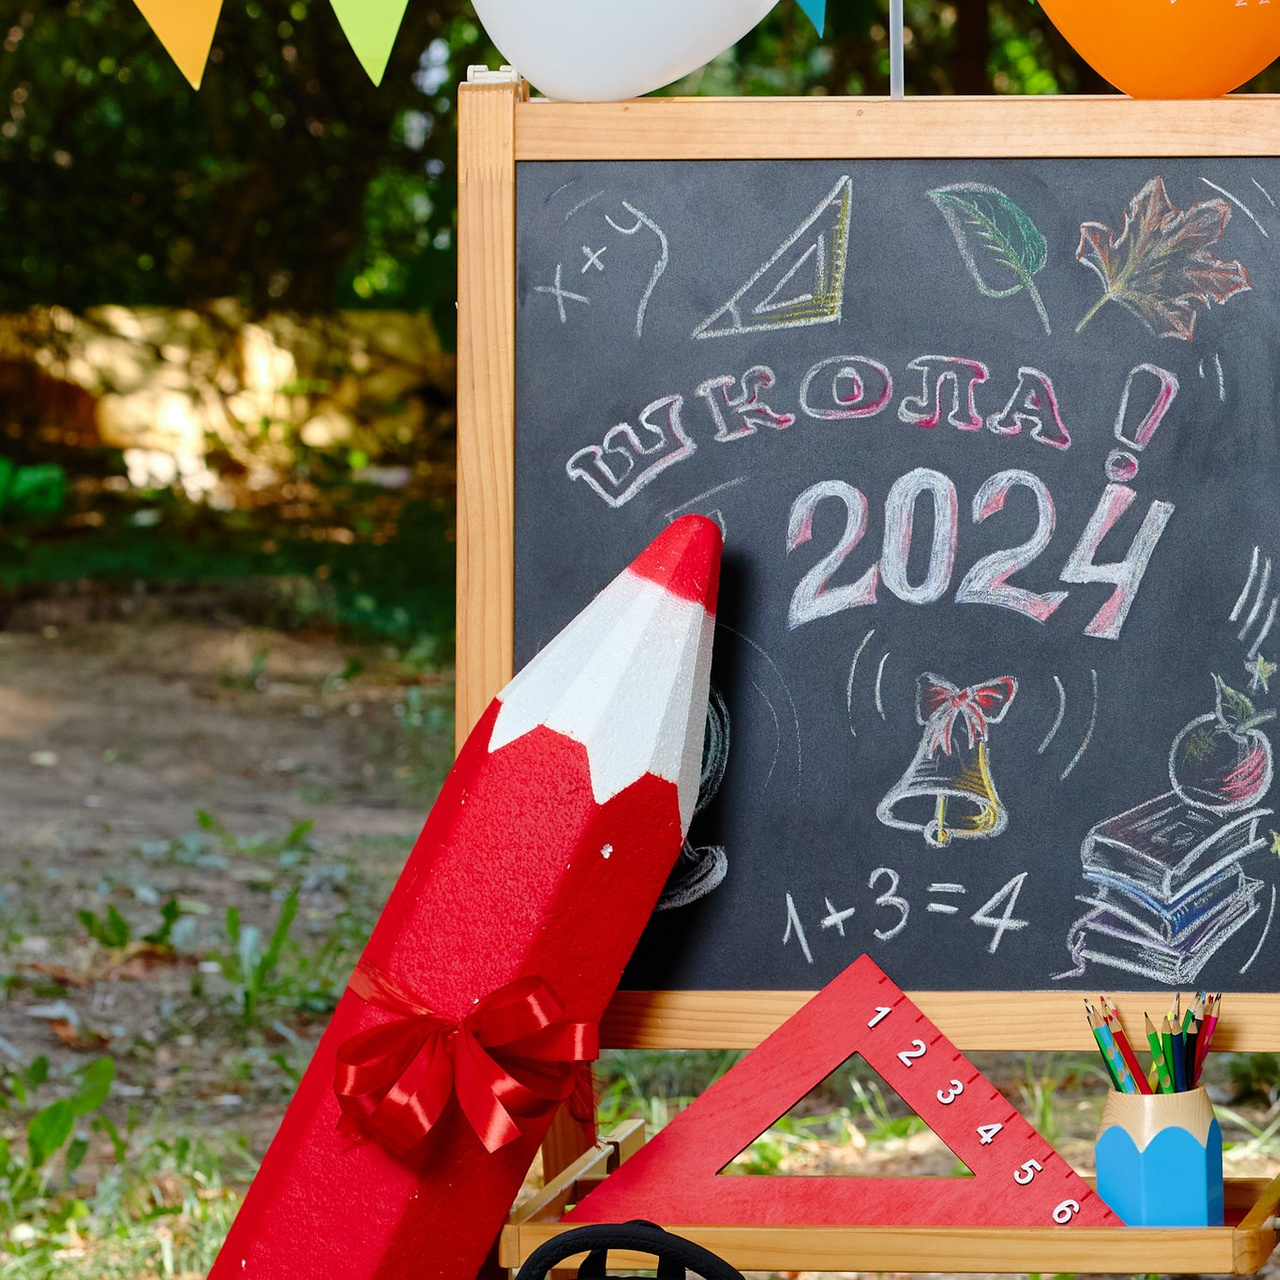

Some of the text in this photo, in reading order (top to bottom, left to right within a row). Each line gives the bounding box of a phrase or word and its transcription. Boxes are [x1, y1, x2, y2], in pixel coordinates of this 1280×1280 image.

[786, 467, 1176, 641] 2024
[867, 1006, 1081, 1224] 1 2 3 4 5 6
